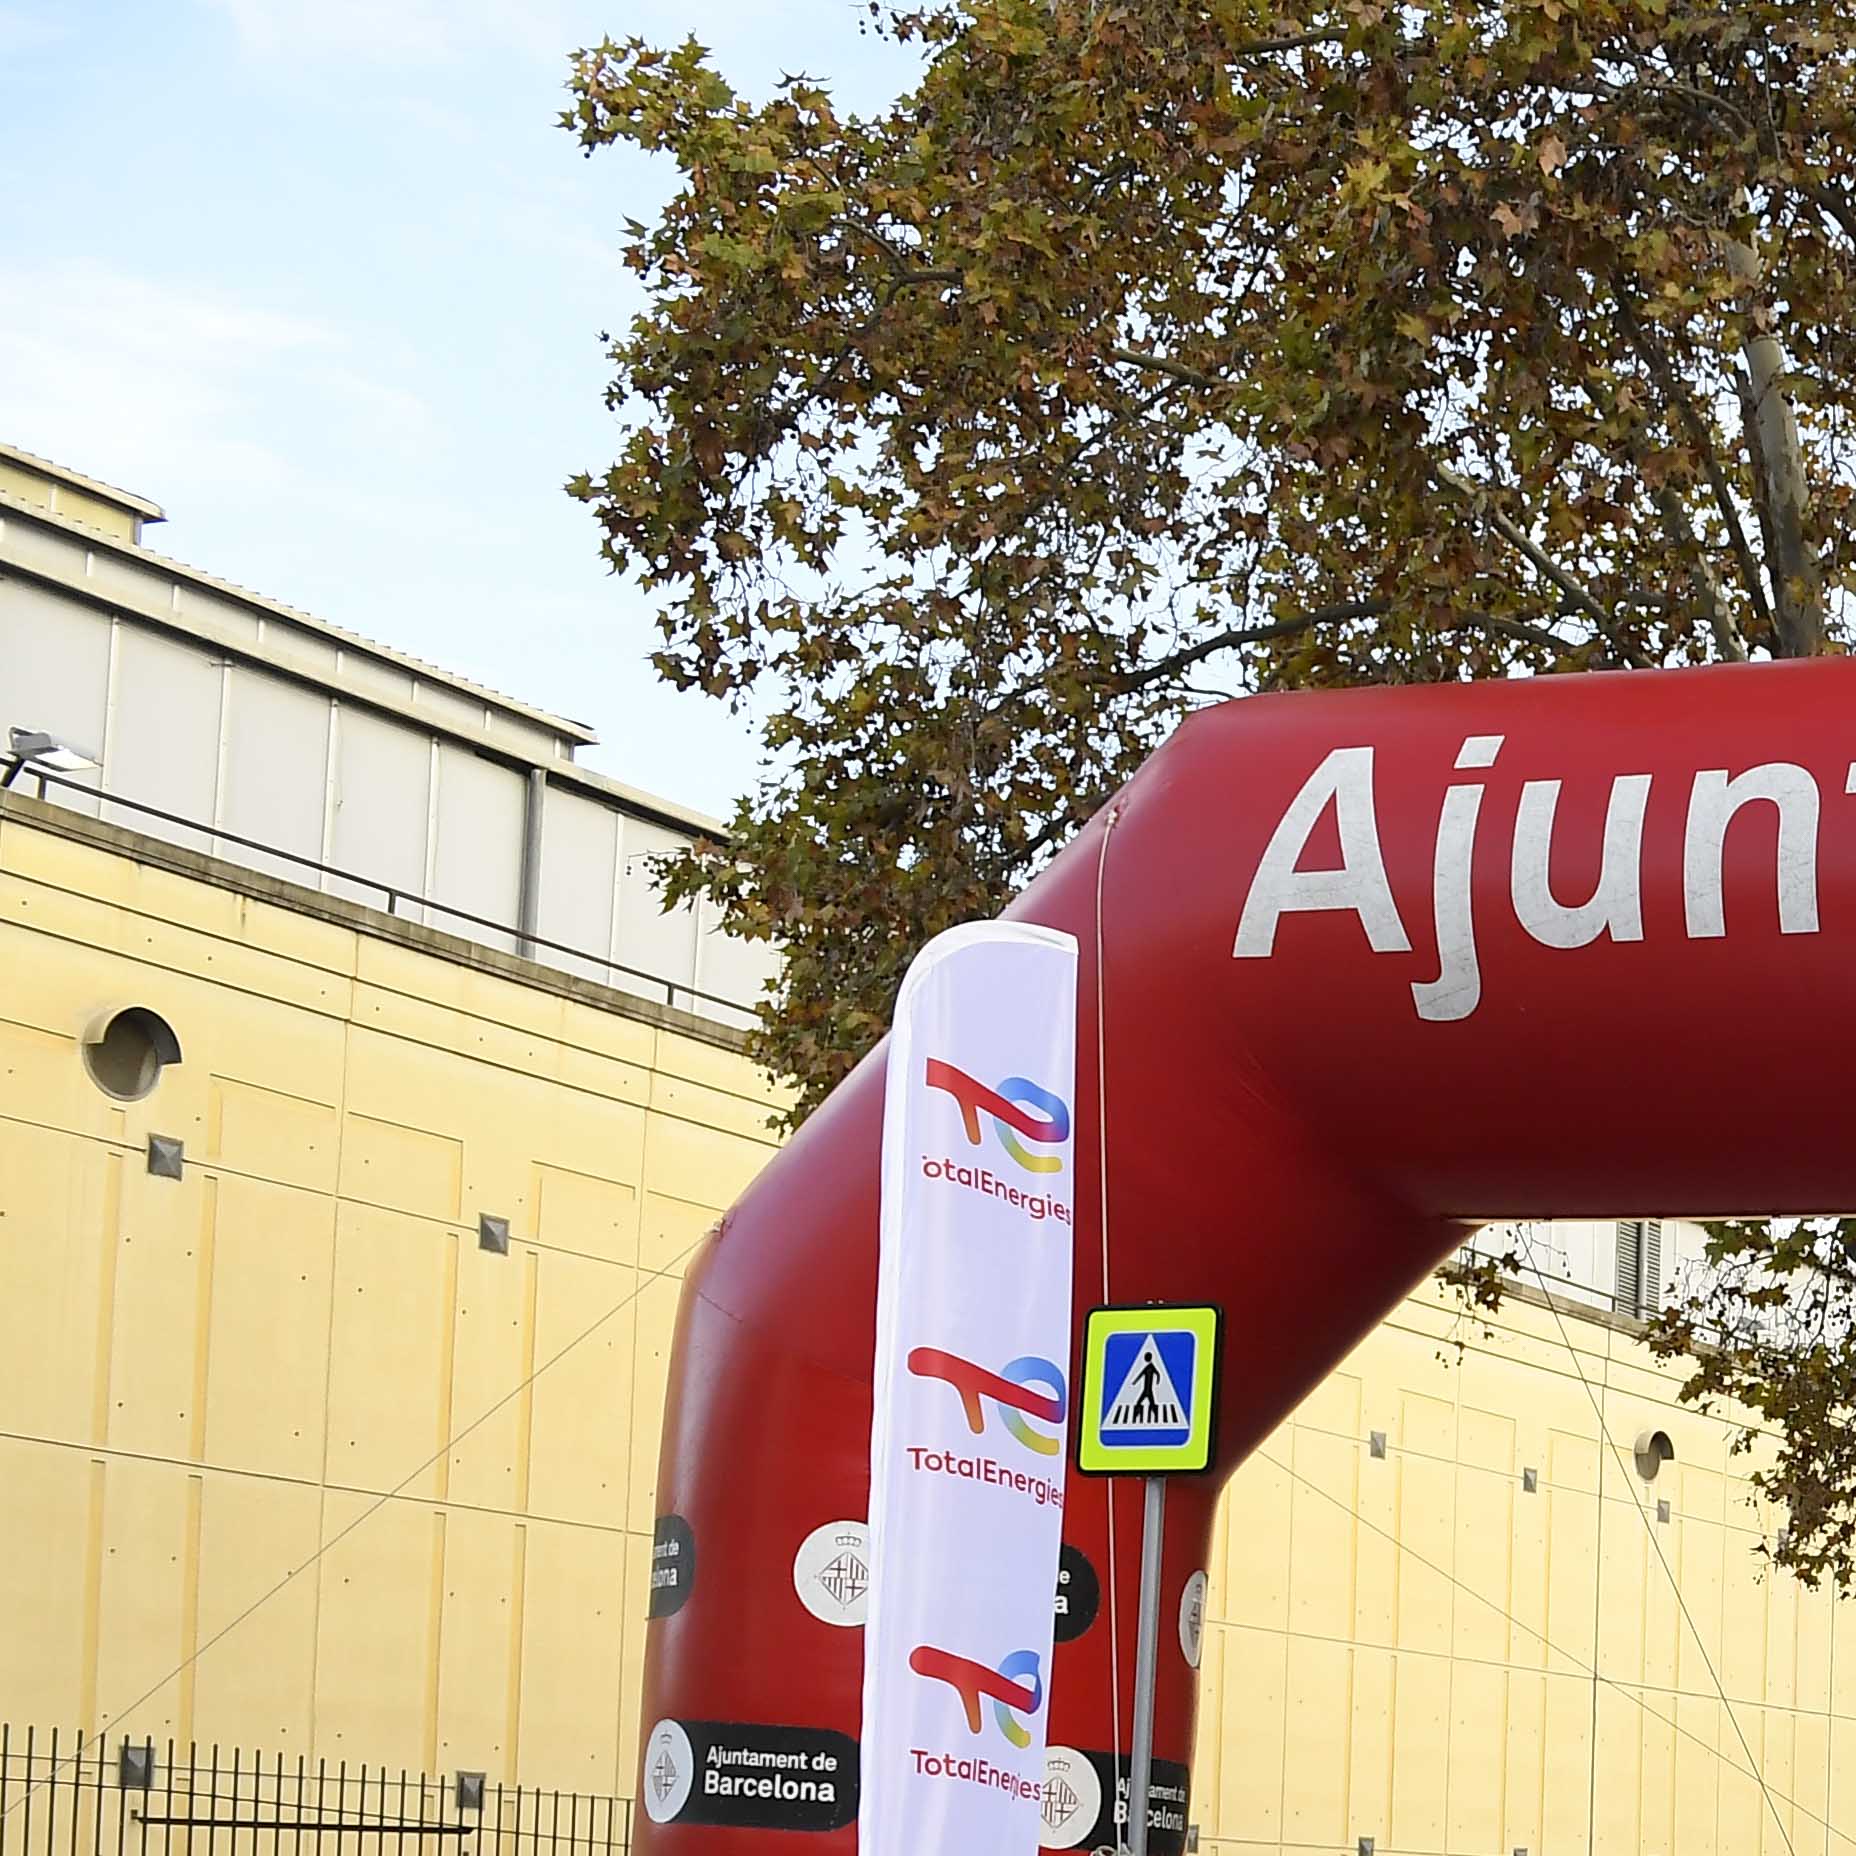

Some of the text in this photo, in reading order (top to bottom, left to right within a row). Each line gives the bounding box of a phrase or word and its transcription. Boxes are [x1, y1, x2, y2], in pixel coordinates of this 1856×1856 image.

[706, 1745, 837, 1772] Ajuntament de
[704, 1770, 836, 1802] Barcelona
